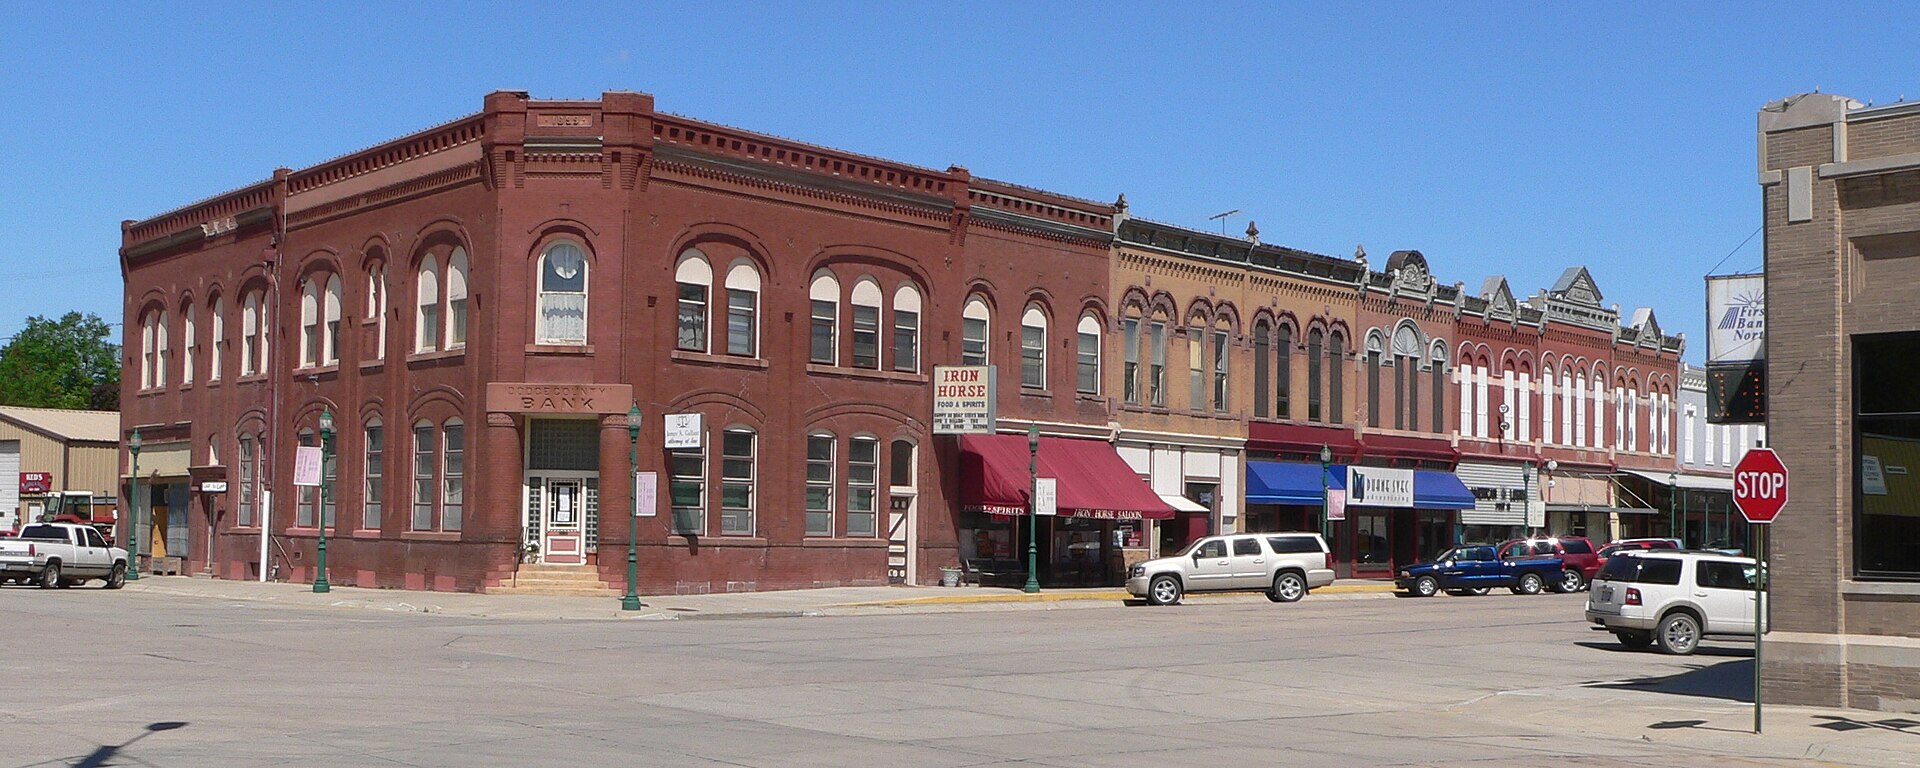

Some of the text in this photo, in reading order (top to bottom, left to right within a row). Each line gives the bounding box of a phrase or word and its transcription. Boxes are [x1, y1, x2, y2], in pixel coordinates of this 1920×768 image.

[1740, 306, 1765, 317] Firs
[1737, 318, 1763, 329] Ban
[1733, 330, 1763, 341] Nort
[944, 370, 979, 382] IRON
[937, 385, 986, 398] HORSE
[522, 397, 593, 409] BANK
[1366, 478, 1409, 493] DUANE SVEC
[1737, 471, 1784, 499] STOP
[991, 506, 1025, 515] SPIRITS
[1073, 508, 1143, 520] IRON HORSE SALOON
